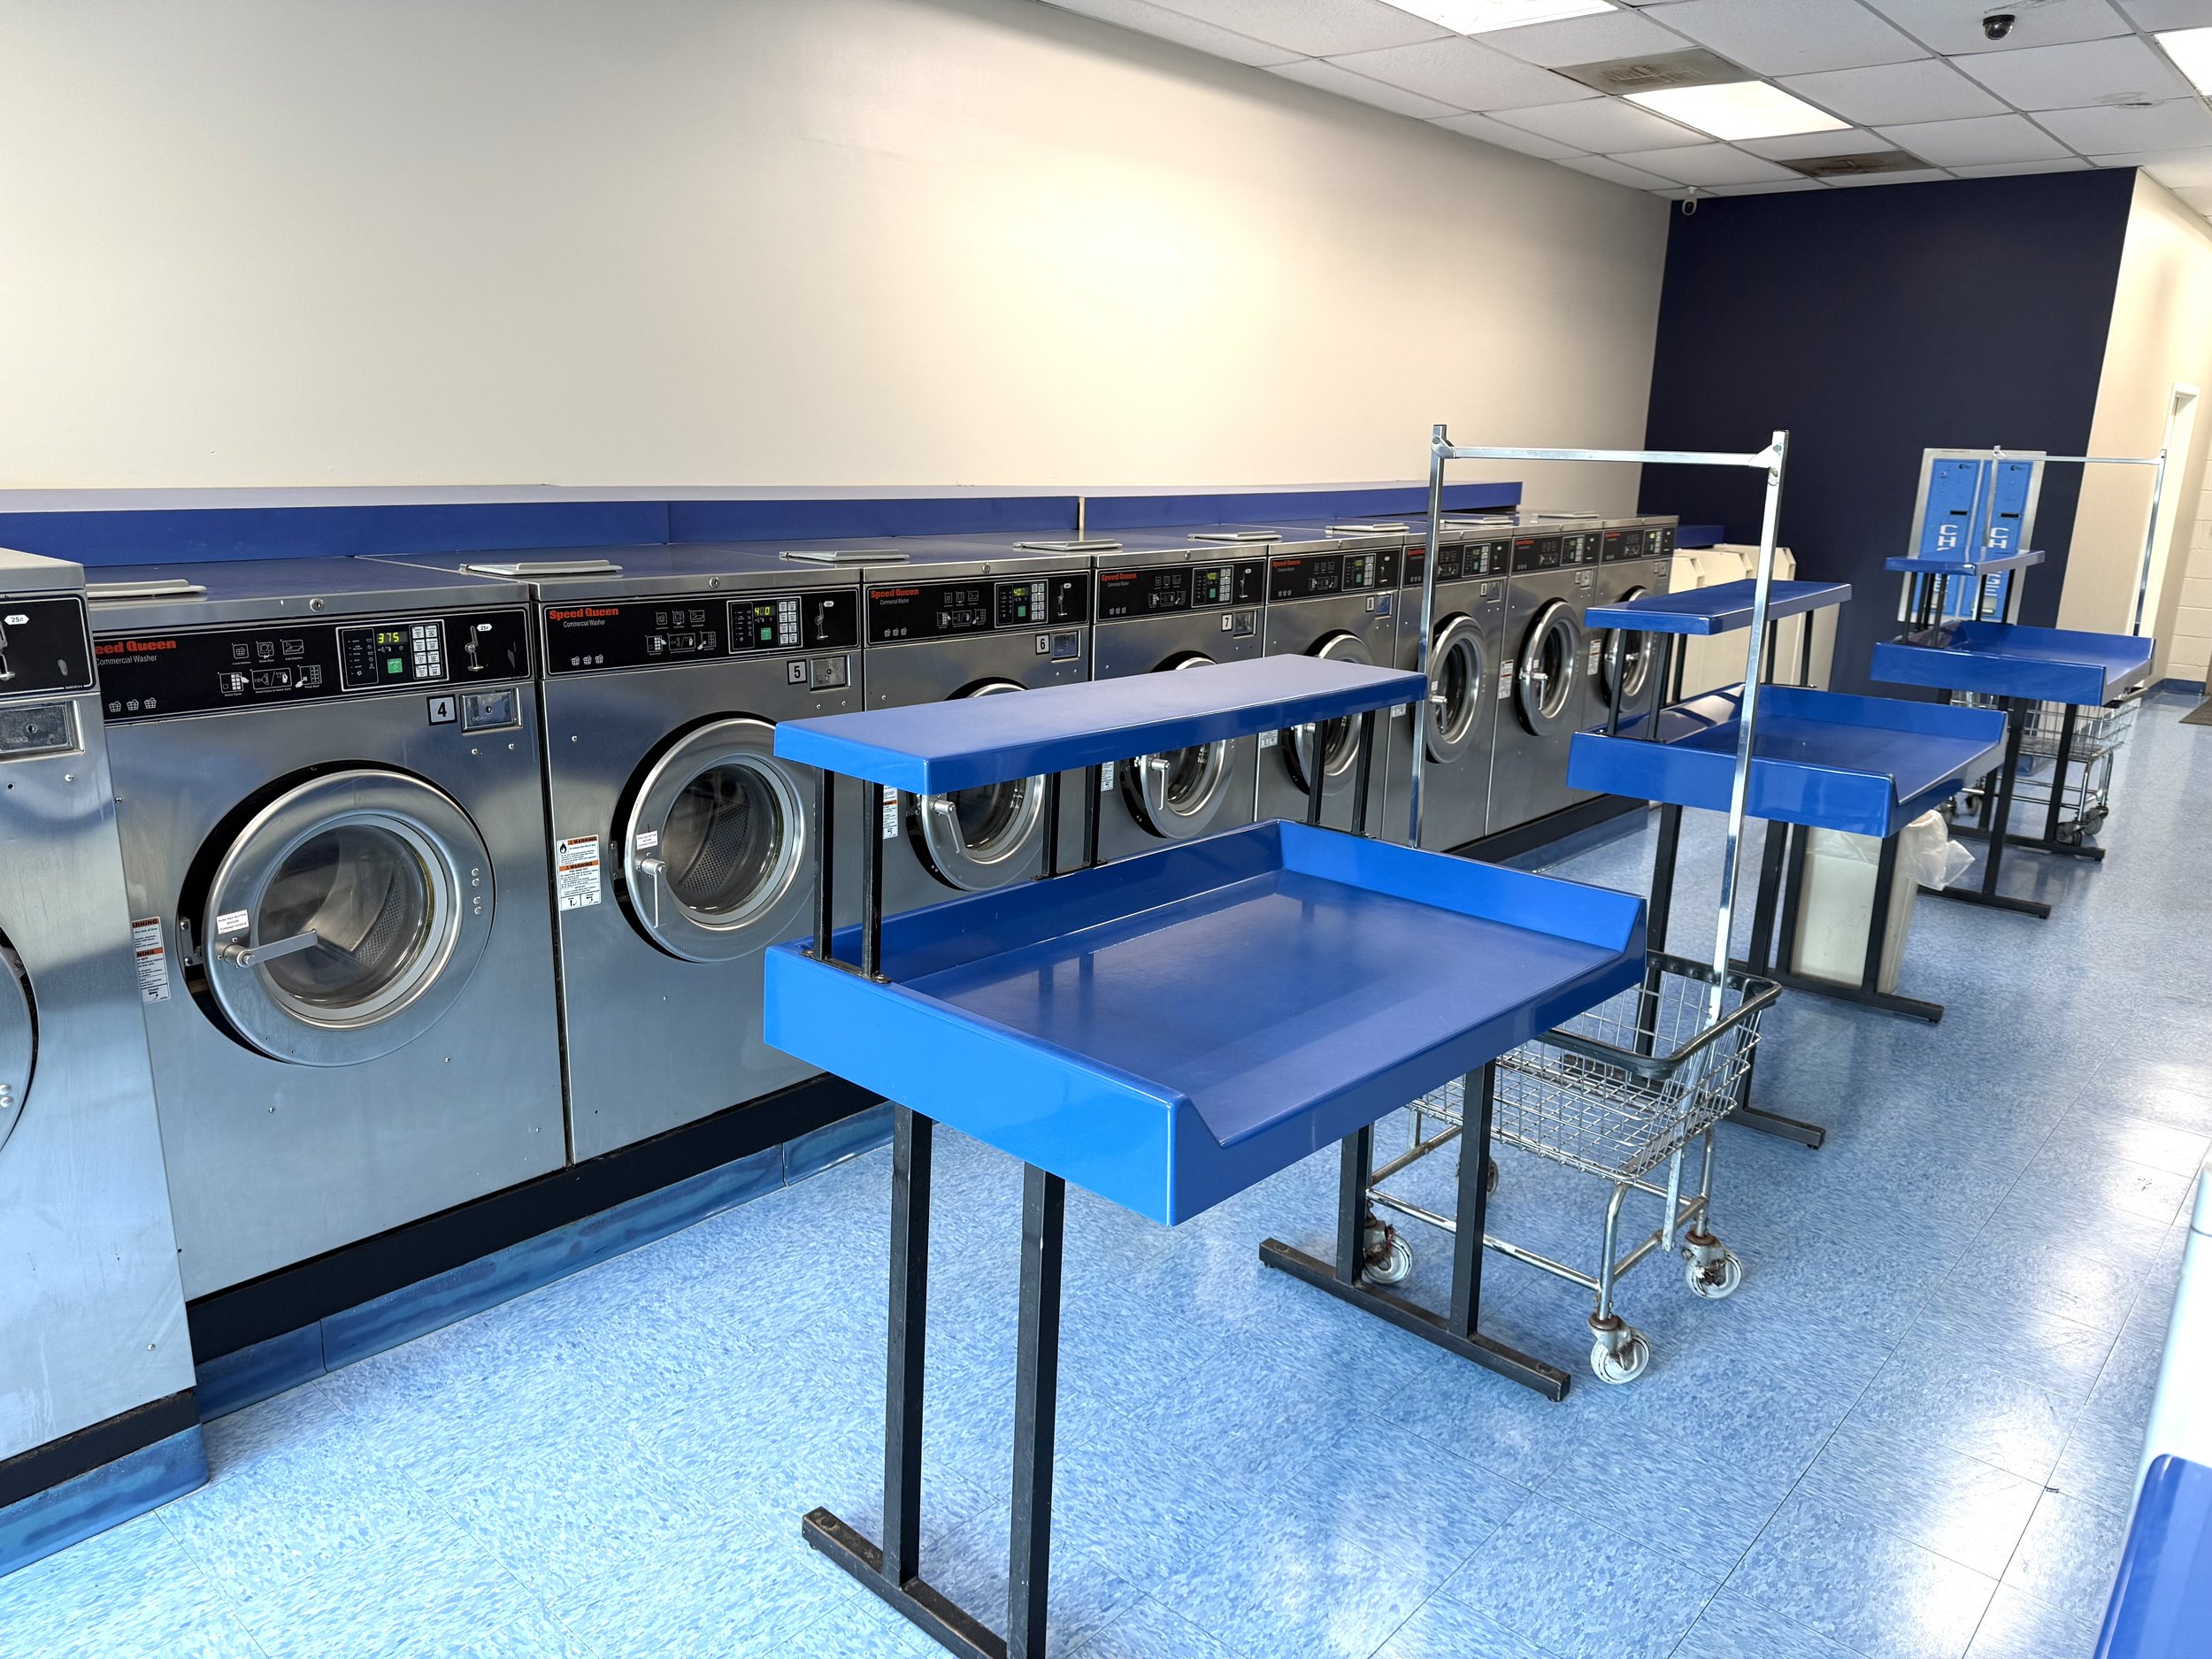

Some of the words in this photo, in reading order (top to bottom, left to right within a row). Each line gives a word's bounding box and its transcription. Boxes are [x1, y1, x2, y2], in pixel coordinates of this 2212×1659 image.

[1984, 527, 2009, 596] CHGE
[871, 589, 895, 599] Speed
[549, 608, 584, 621] Speed
[585, 607, 619, 617] Queen
[754, 606, 770, 616] 400
[378, 632, 399, 643] 375
[1040, 638, 1046, 649] 6
[96, 641, 124, 655] eed
[127, 640, 177, 652] Queen
[96, 657, 133, 666] Commercial
[794, 664, 801, 680] 5
[437, 701, 447, 718] 4
